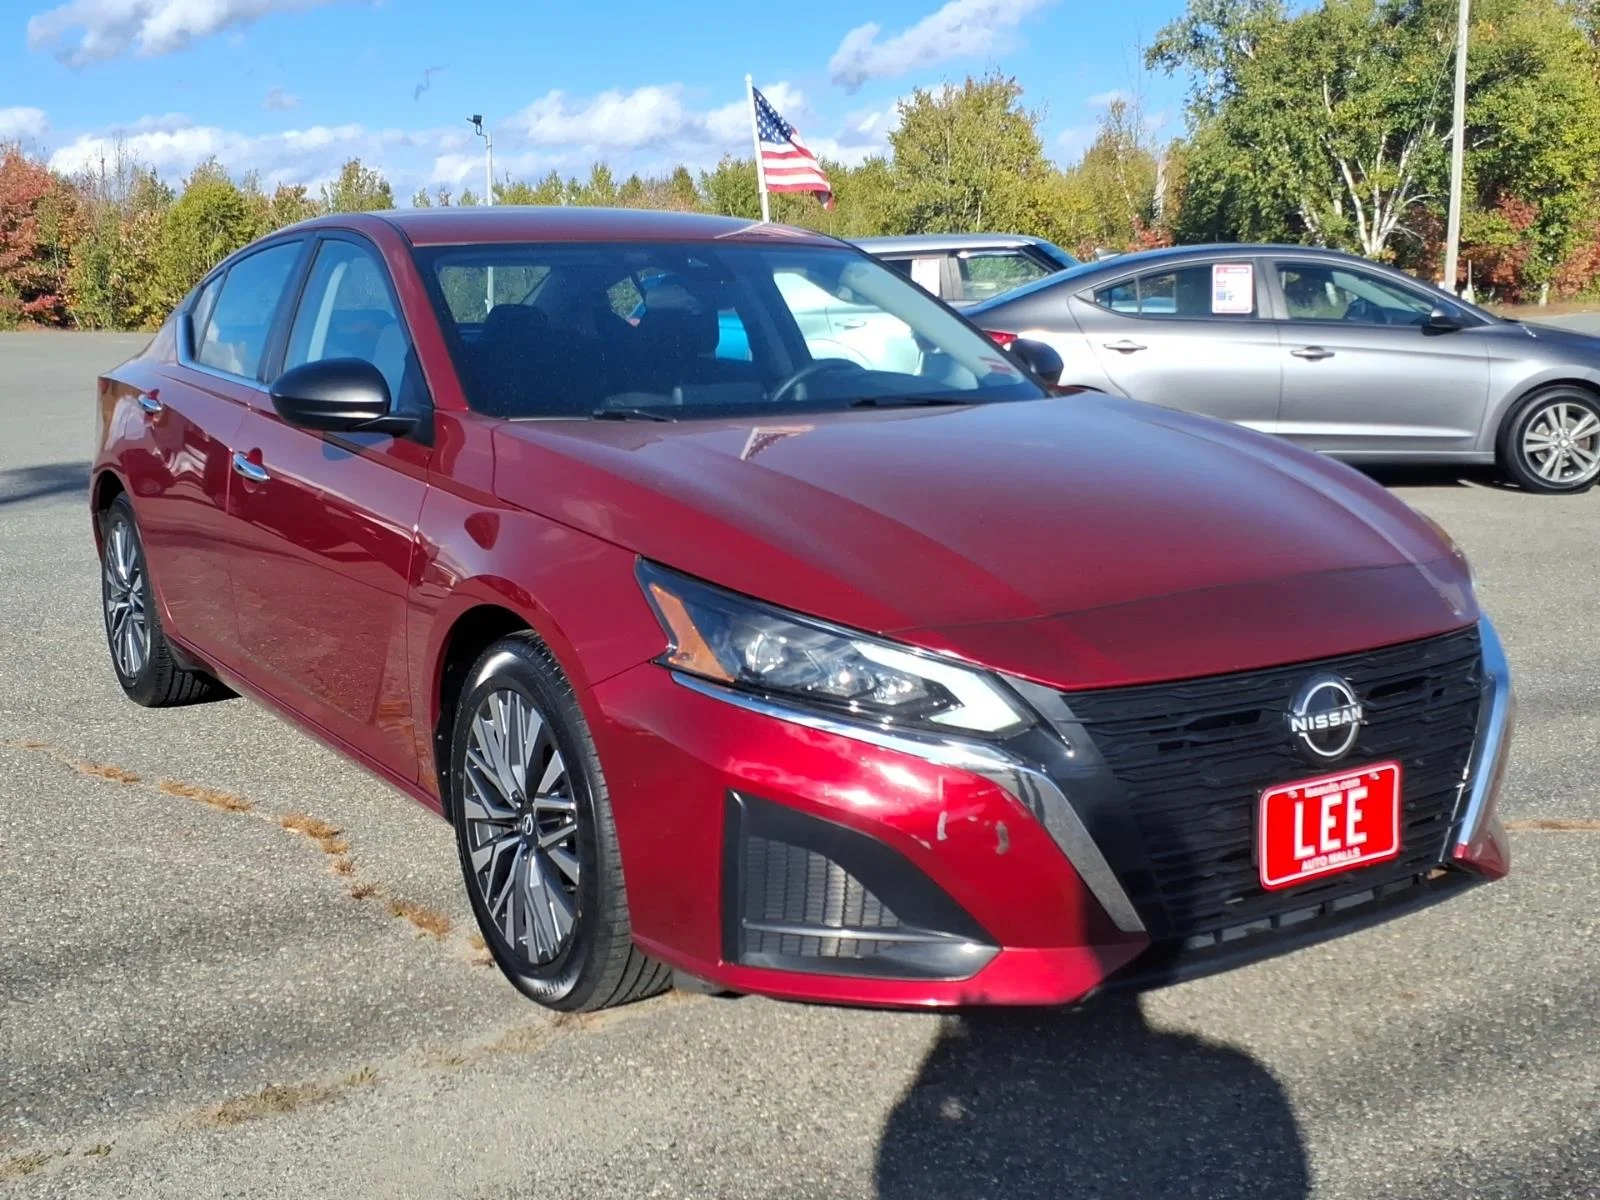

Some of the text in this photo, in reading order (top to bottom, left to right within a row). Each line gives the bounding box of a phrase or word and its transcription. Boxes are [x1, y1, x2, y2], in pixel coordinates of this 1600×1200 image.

[1291, 706, 1362, 732] NISSAN
[1294, 786, 1368, 860] LEE
[1301, 855, 1327, 872] AUTO
